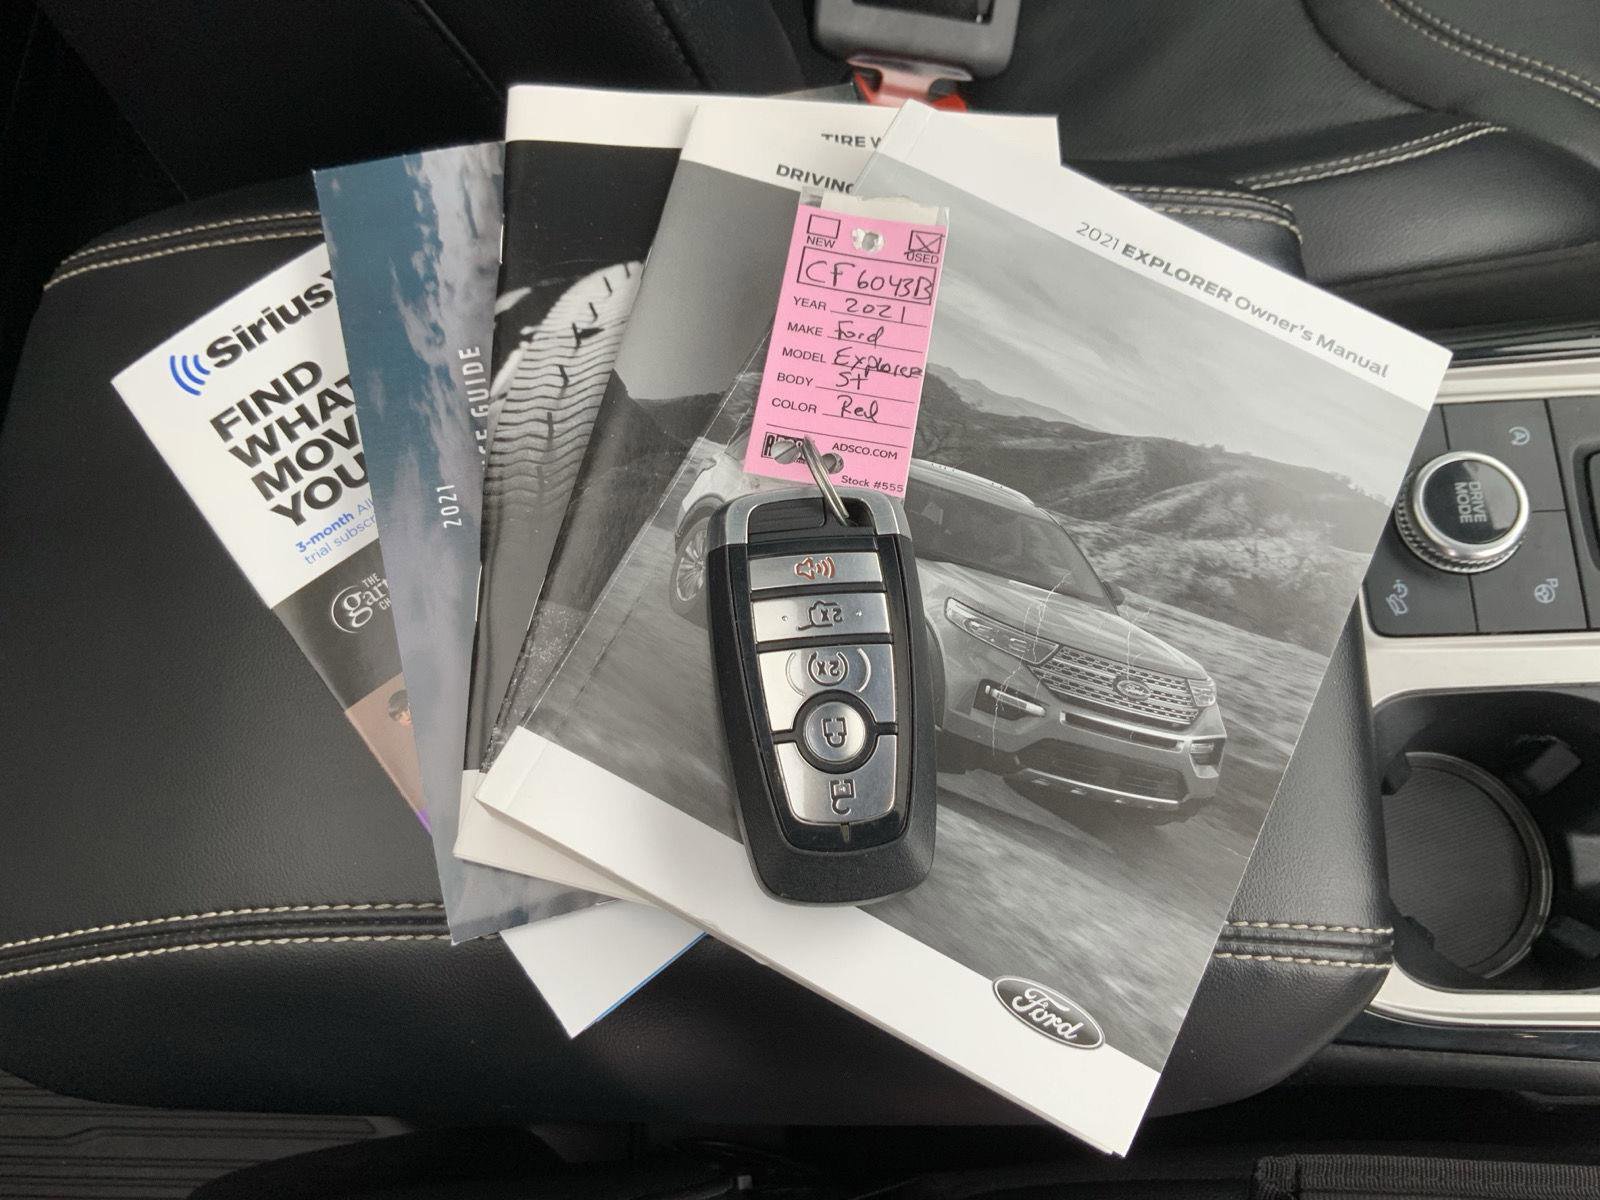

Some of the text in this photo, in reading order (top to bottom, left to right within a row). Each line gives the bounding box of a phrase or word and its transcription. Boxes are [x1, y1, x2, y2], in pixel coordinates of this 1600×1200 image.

[821, 133, 866, 148] TIRE
[807, 235, 836, 249] NEW
[906, 252, 939, 265] USED
[793, 296, 827, 311] YEAR
[845, 298, 907, 324] 2021
[1076, 221, 1389, 378] 2021 EXPLORER Owner's Manual
[206, 271, 335, 368] Sirius
[787, 322, 823, 337] MAKE
[834, 320, 885, 348] Ford
[782, 348, 826, 364] MODEL
[458, 346, 490, 418] GUIDE
[777, 373, 813, 388] BODY
[209, 360, 323, 443] FIND
[771, 398, 817, 415] COLOR
[837, 395, 879, 423] Red
[832, 442, 898, 460] ADSCO.COM
[841, 475, 904, 493] Stock #555
[436, 484, 463, 529] 2021
[1454, 481, 1474, 525] MODE
[1468, 480, 1487, 523] DRIVE
[295, 512, 355, 553] 3-month
[304, 542, 332, 565] trial
[361, 572, 381, 588] THE
[1012, 988, 1084, 1039] Ford
